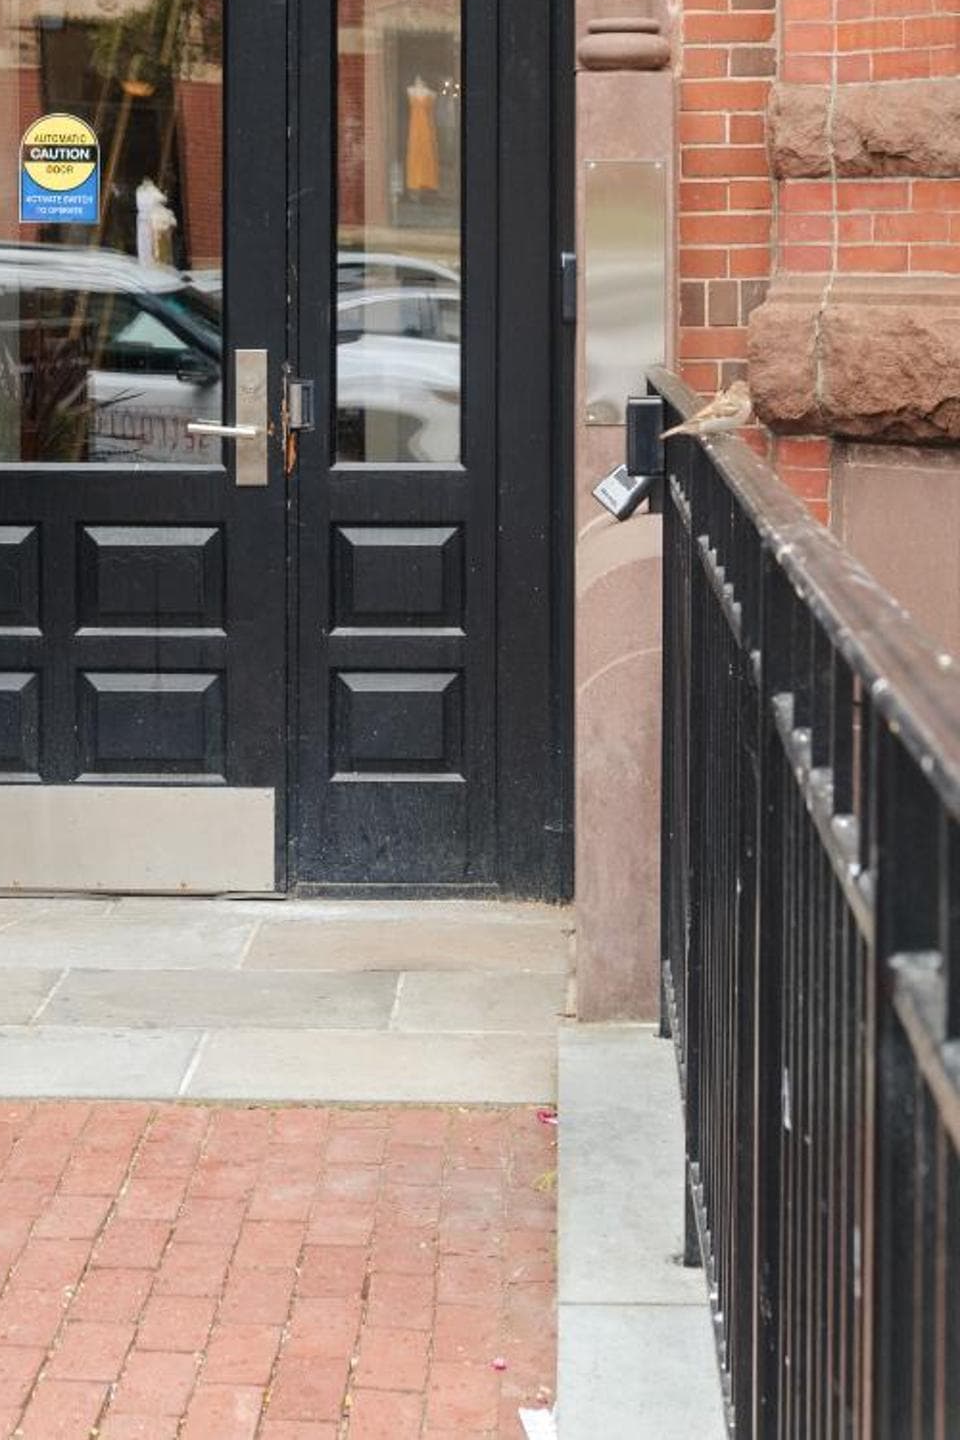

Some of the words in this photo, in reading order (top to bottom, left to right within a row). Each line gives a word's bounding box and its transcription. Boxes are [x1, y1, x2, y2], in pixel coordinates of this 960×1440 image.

[34, 133, 87, 143] AUTOMATIC
[30, 147, 90, 160] CAUTION
[46, 164, 74, 174] DOOR
[26, 195, 62, 204] ACTIVATE
[62, 195, 93, 204] SWITCH
[48, 206, 83, 215] OPERATE
